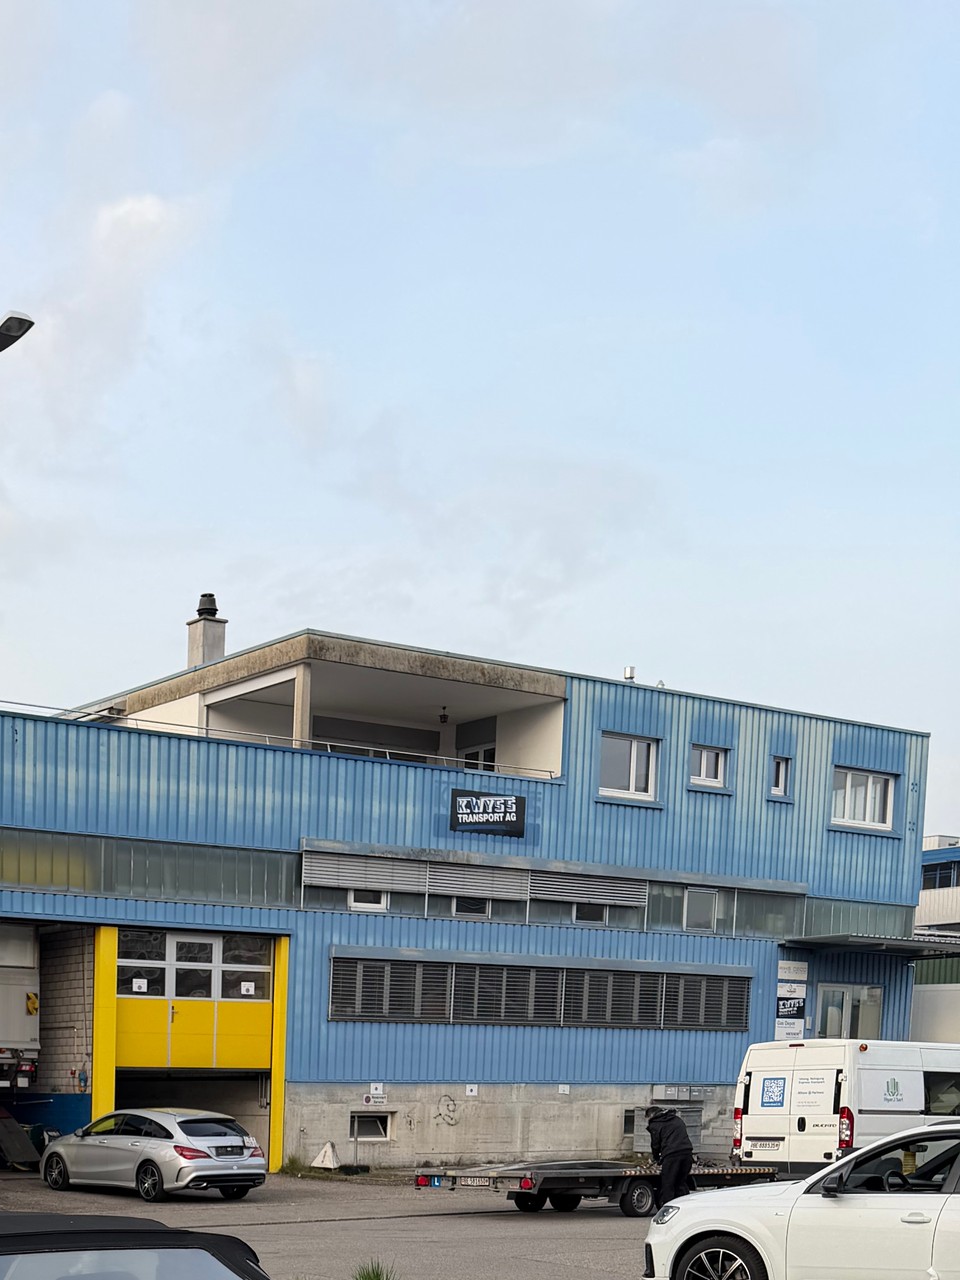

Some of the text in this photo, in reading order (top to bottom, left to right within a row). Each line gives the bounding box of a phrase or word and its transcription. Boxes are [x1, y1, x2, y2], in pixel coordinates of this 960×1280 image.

[457, 812, 517, 823] TRANSPORT AG
[434, 1177, 440, 1186] L
